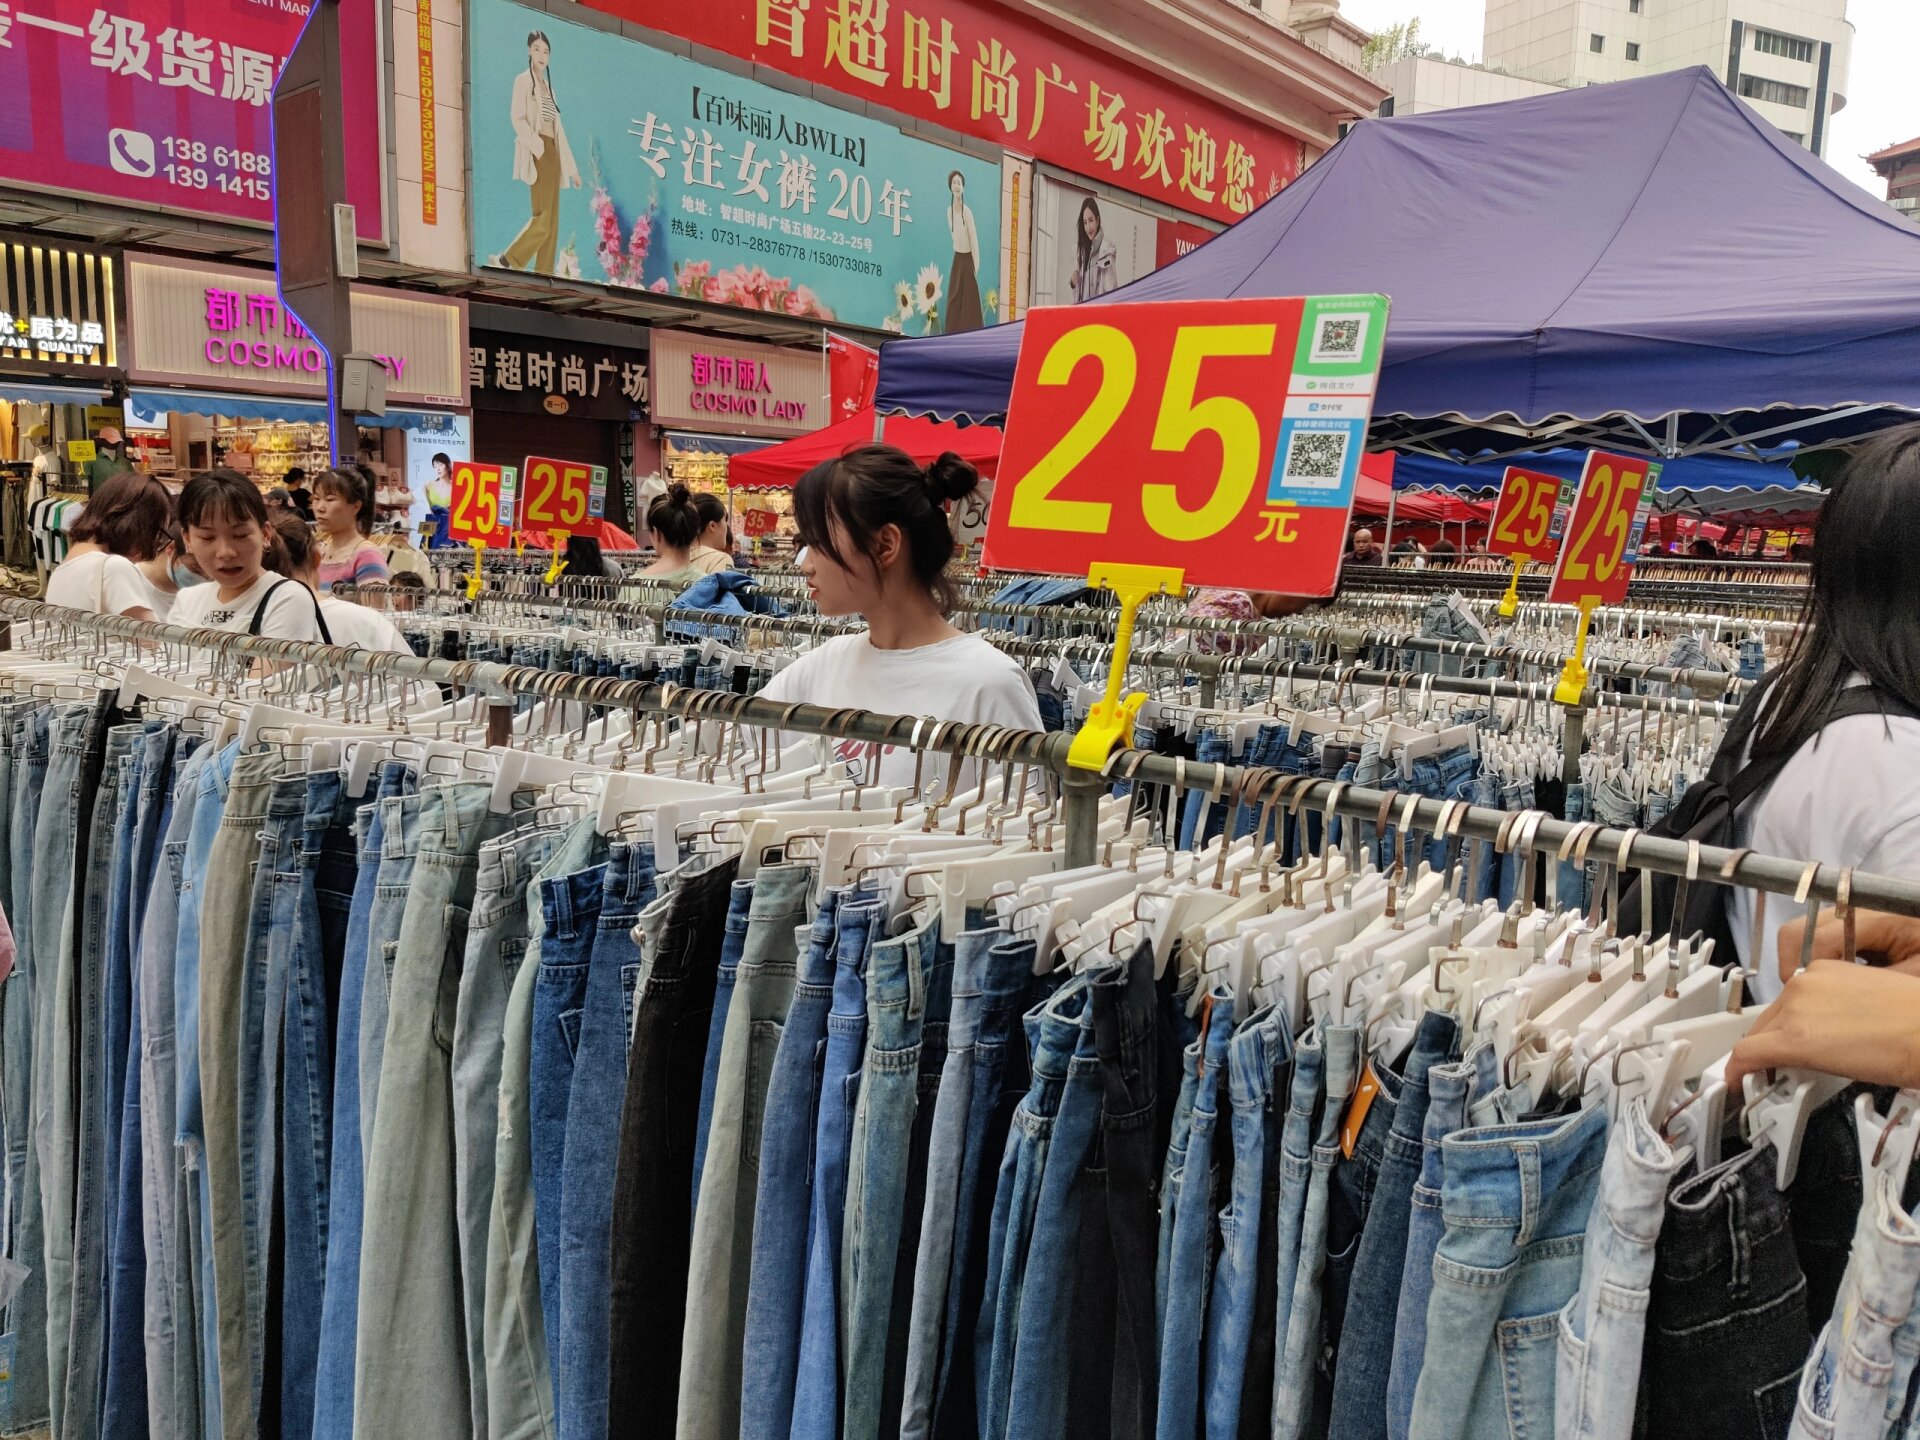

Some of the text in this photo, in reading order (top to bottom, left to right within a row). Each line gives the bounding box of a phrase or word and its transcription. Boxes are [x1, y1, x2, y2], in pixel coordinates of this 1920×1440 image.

[755, 0, 1257, 214] 智超时尚广场欢迎您
[161, 136, 271, 176] 138 6188
[163, 163, 271, 200] 139 1415
[38, 339, 93, 355] QUALITY
[205, 337, 322, 372] COSMO
[469, 347, 649, 403] 智超时尚广场
[691, 353, 772, 393] 都市丽人
[690, 391, 807, 421] COSMO LADY
[1007, 323, 1277, 542] 25
[453, 467, 499, 534] 25
[527, 463, 588, 525] 25
[1495, 475, 1557, 547] 25
[1562, 464, 1642, 582] 25
